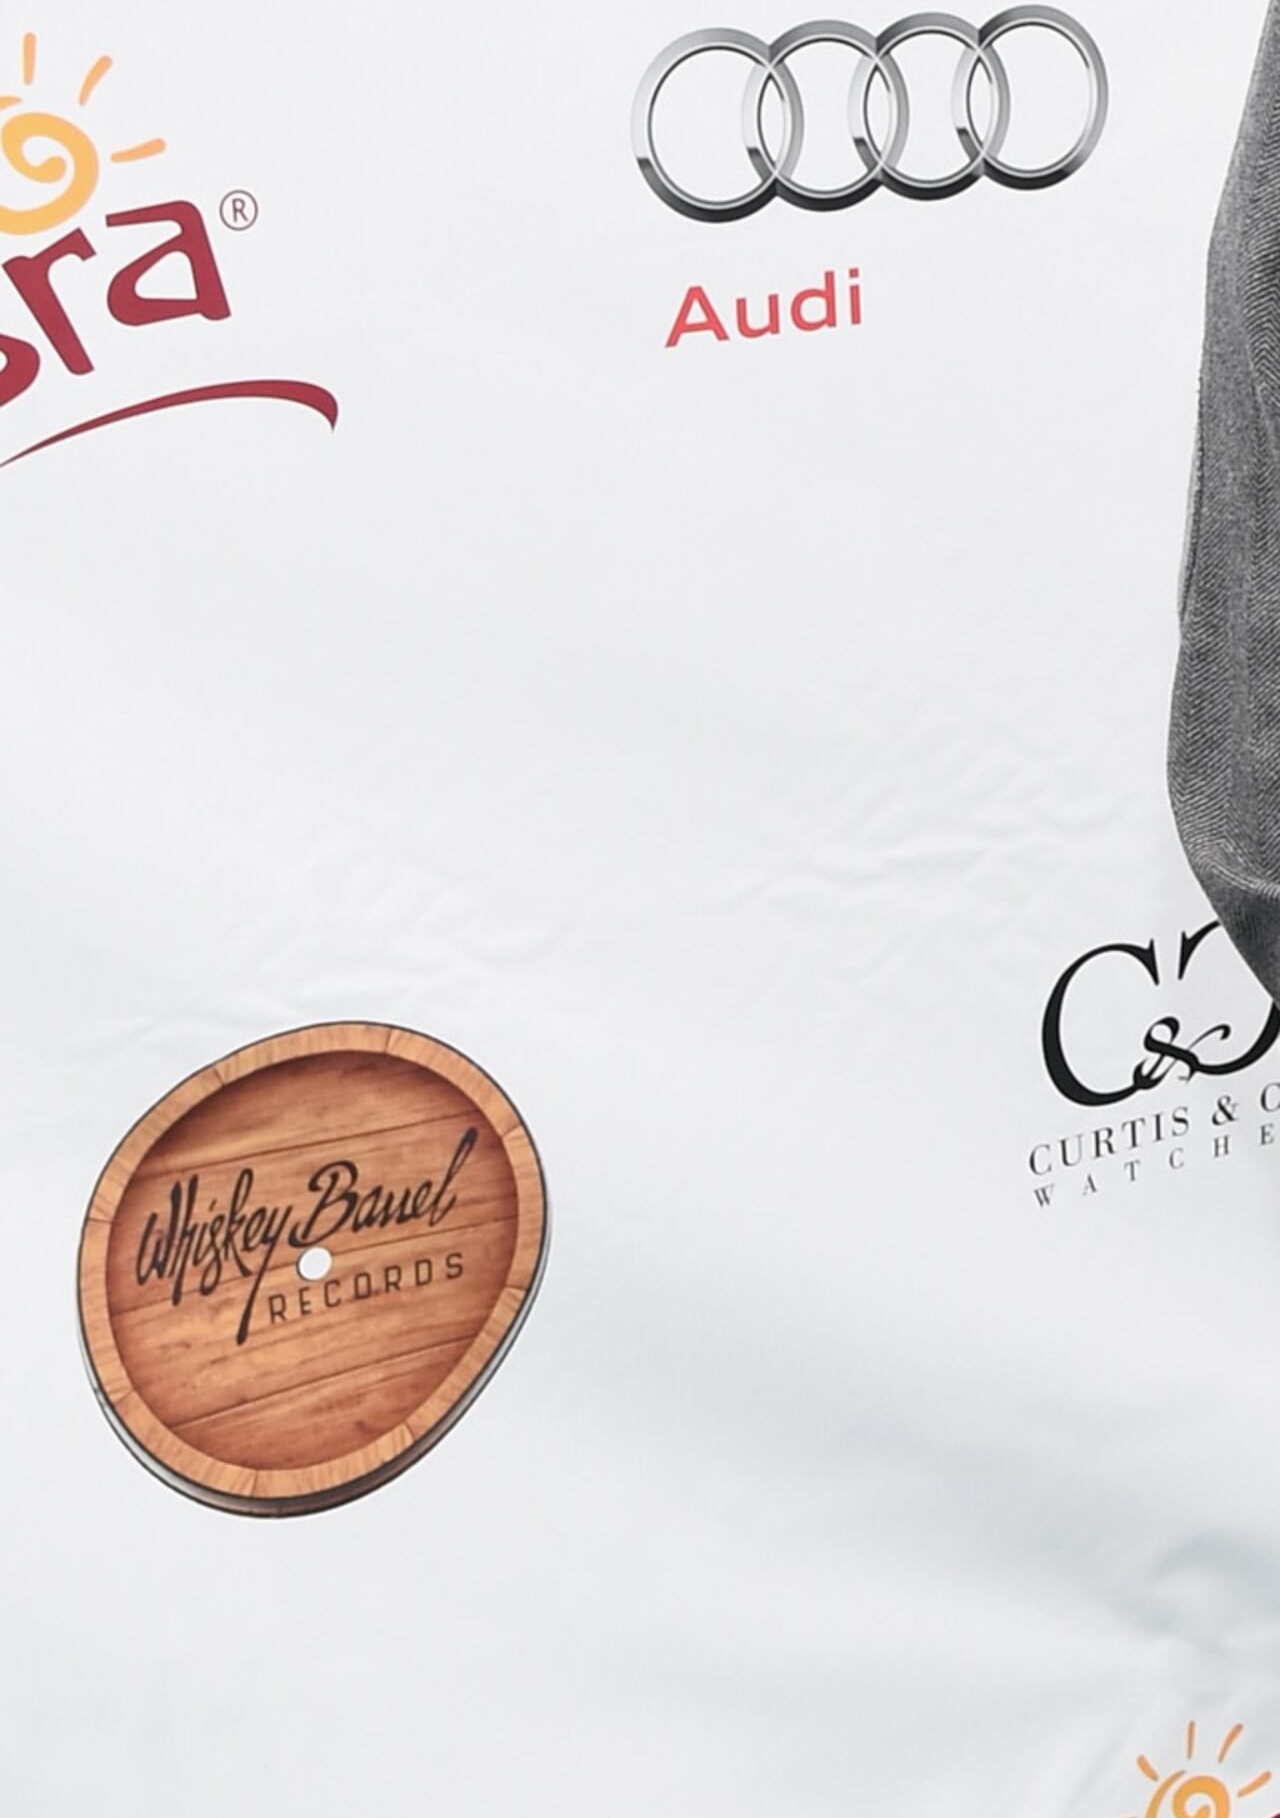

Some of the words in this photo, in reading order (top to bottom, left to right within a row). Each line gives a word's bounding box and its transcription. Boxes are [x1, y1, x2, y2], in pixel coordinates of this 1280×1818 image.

[664, 267, 862, 349] Audi
[1028, 1105, 1190, 1177] CURTIS
[1211, 1094, 1239, 1127] &
[136, 1167, 293, 1346] Whiskey
[268, 1251, 464, 1324] RECORDS
